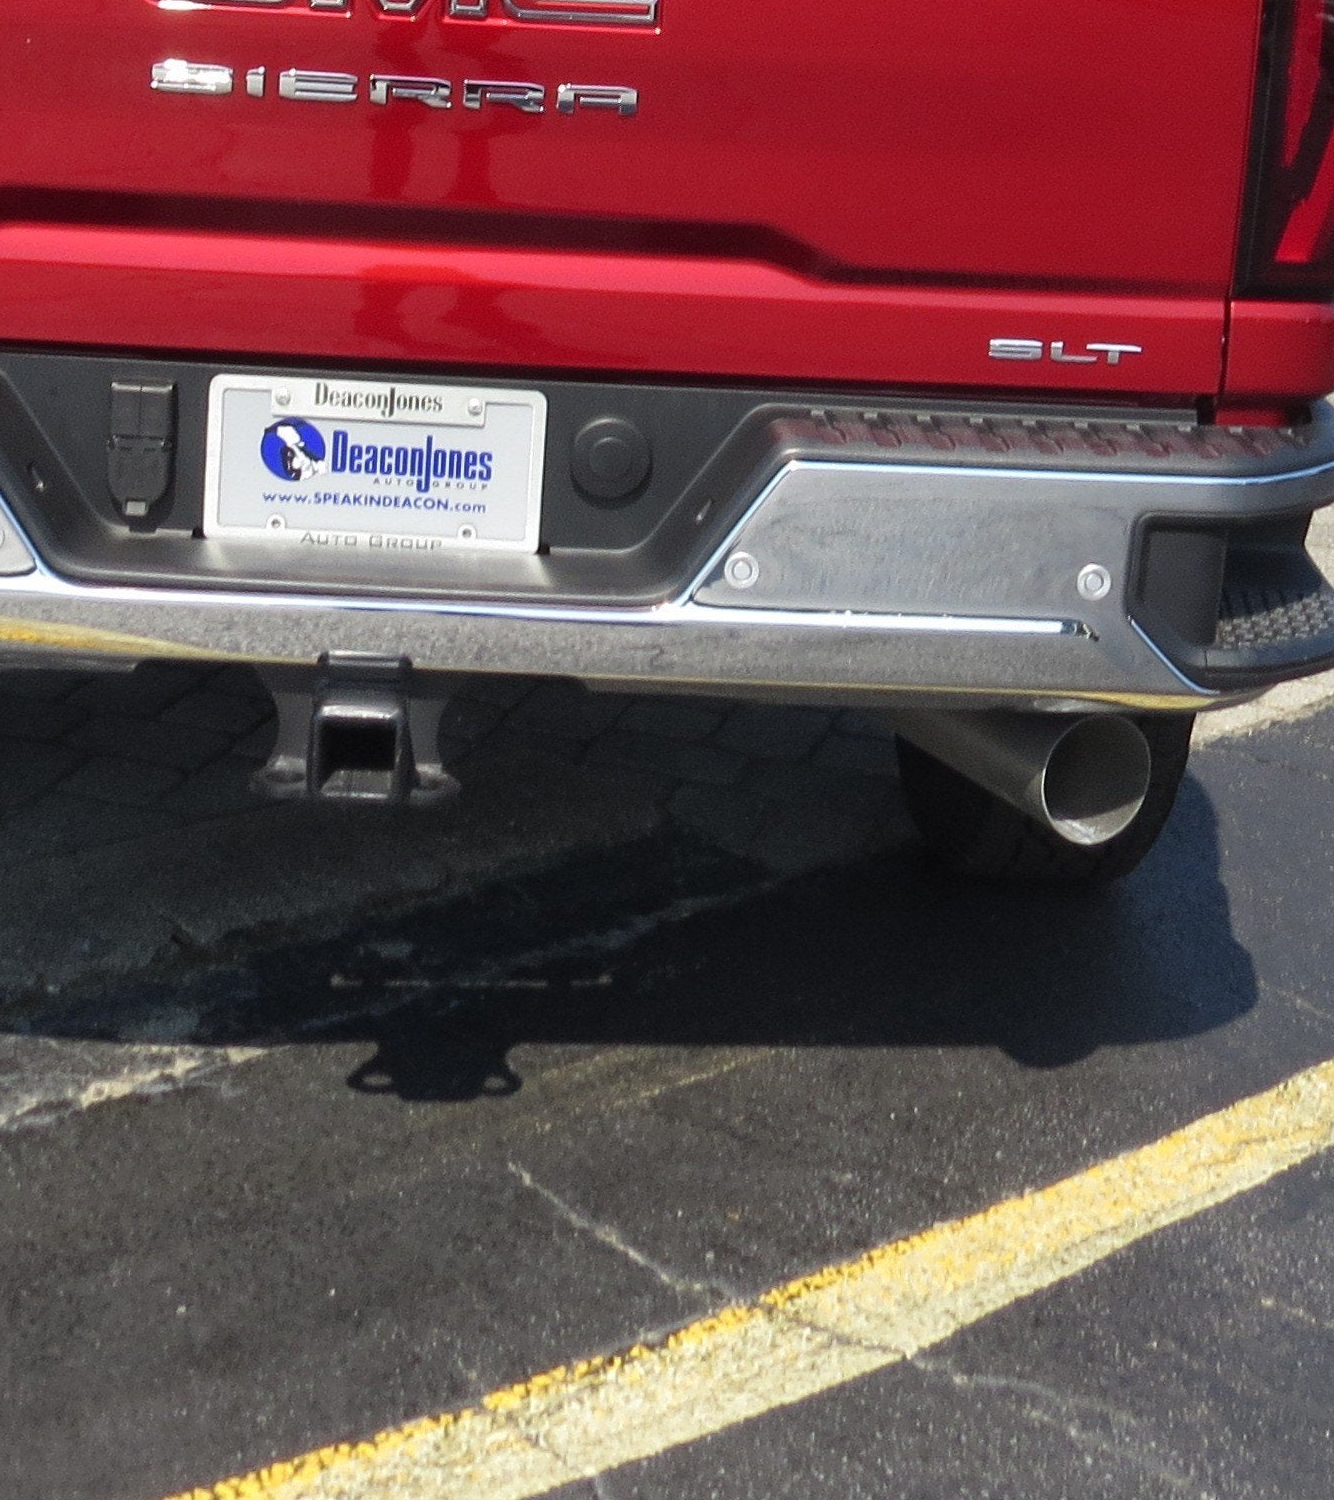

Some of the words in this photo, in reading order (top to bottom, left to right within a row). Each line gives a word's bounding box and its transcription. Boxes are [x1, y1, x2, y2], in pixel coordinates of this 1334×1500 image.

[150, 59, 640, 116] SIERRA
[989, 338, 1142, 365] SLT
[314, 382, 443, 418] DeaconJones
[331, 430, 492, 493] DeaconJones
[372, 477, 414, 488] AUTO
[432, 480, 489, 492] GROUP
[262, 491, 487, 514] www.SPEAKINDEACON.com
